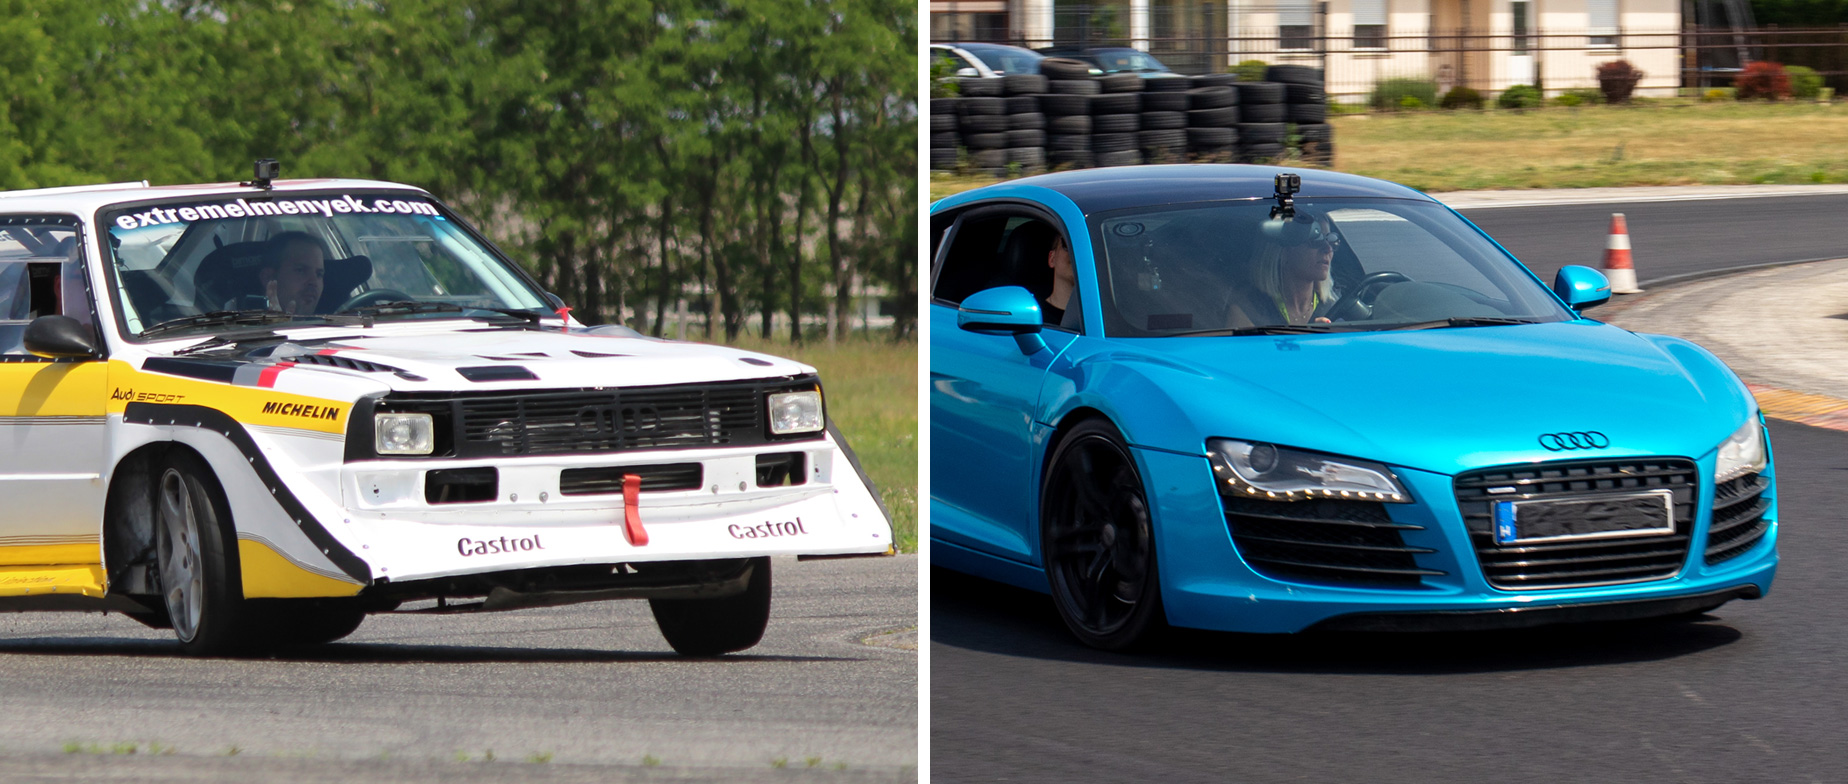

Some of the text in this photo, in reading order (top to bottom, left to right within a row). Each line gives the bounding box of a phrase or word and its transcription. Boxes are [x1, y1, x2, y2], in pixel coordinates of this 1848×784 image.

[116, 195, 440, 230] extremelmenyek.com
[111, 387, 185, 403] Audi SPORT
[262, 401, 340, 421] MICHELIN
[728, 516, 809, 539] Castrol
[457, 534, 546, 557] Castrol
